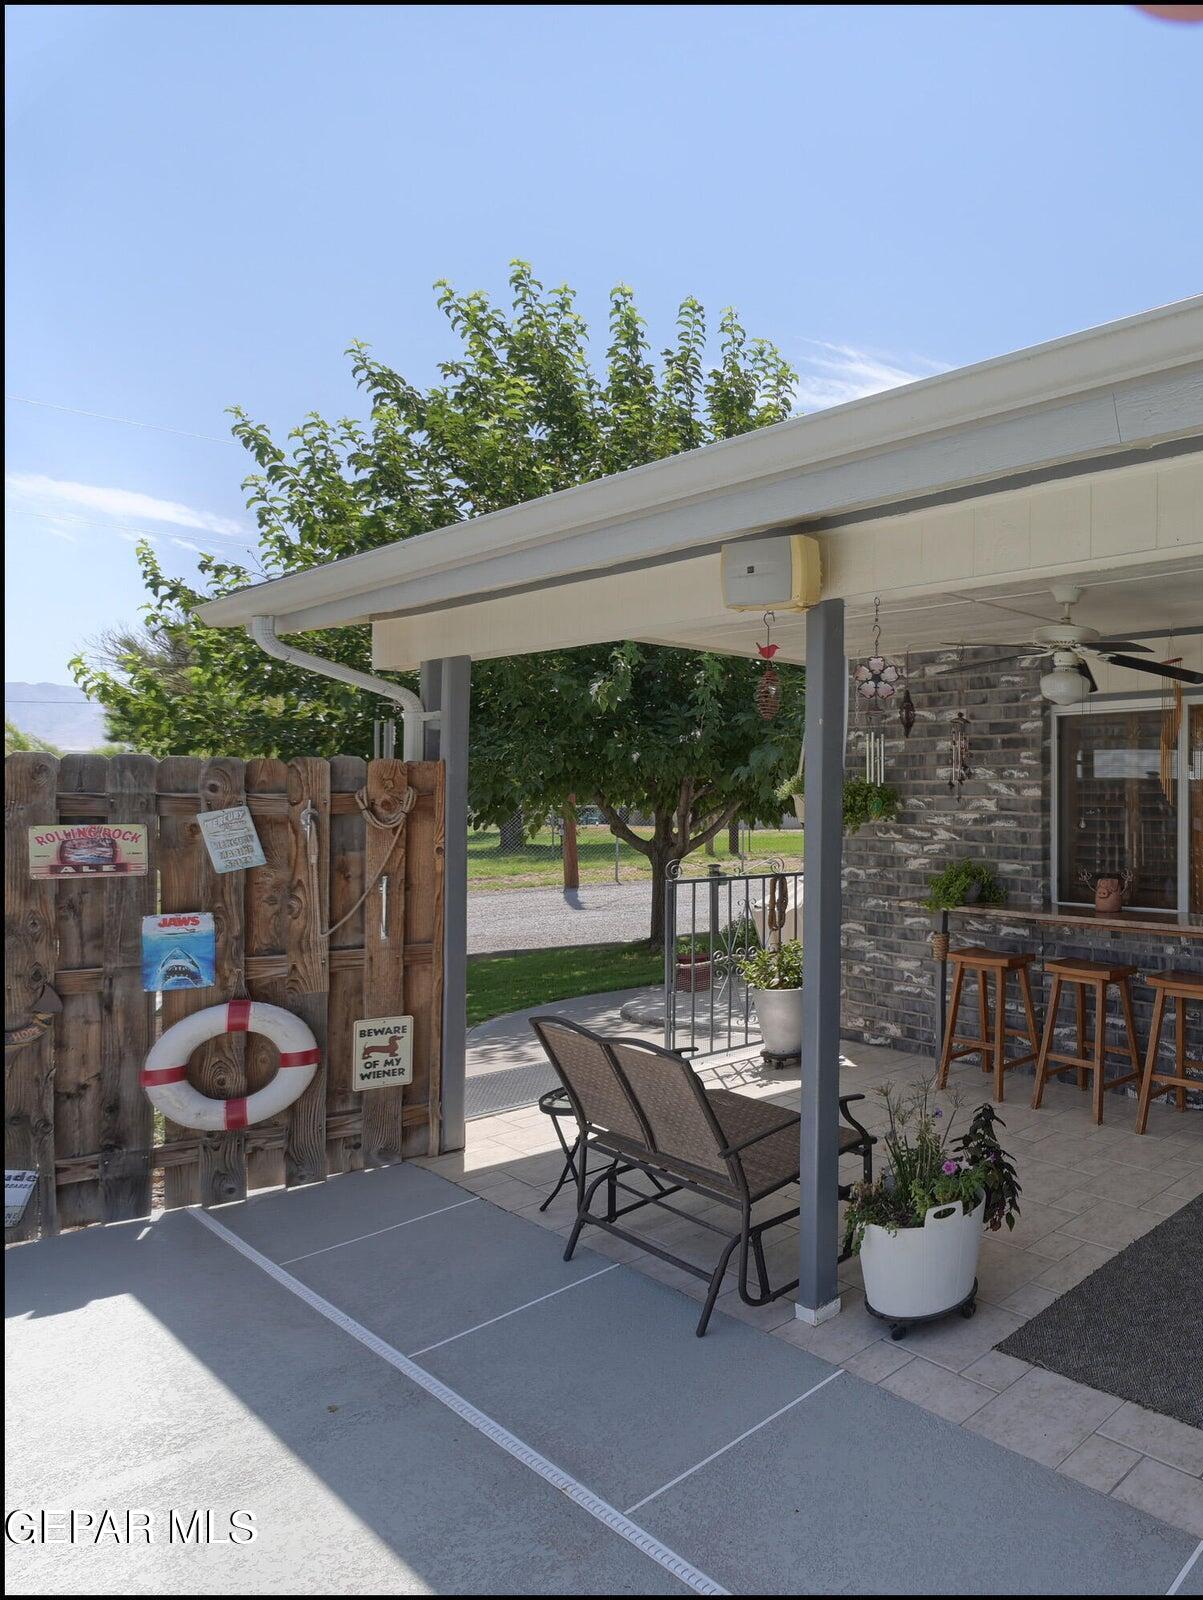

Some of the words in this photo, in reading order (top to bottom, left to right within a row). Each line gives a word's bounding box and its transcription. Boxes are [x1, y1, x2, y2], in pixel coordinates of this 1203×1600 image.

[101, 827, 142, 844] ROCK
[60, 864, 117, 874] ALE
[157, 915, 201, 928] JAWS
[359, 1025, 407, 1038] BEWARE
[364, 1060, 380, 1069] OF
[383, 1057, 402, 1068] MY
[359, 1067, 406, 1081] WIENER
